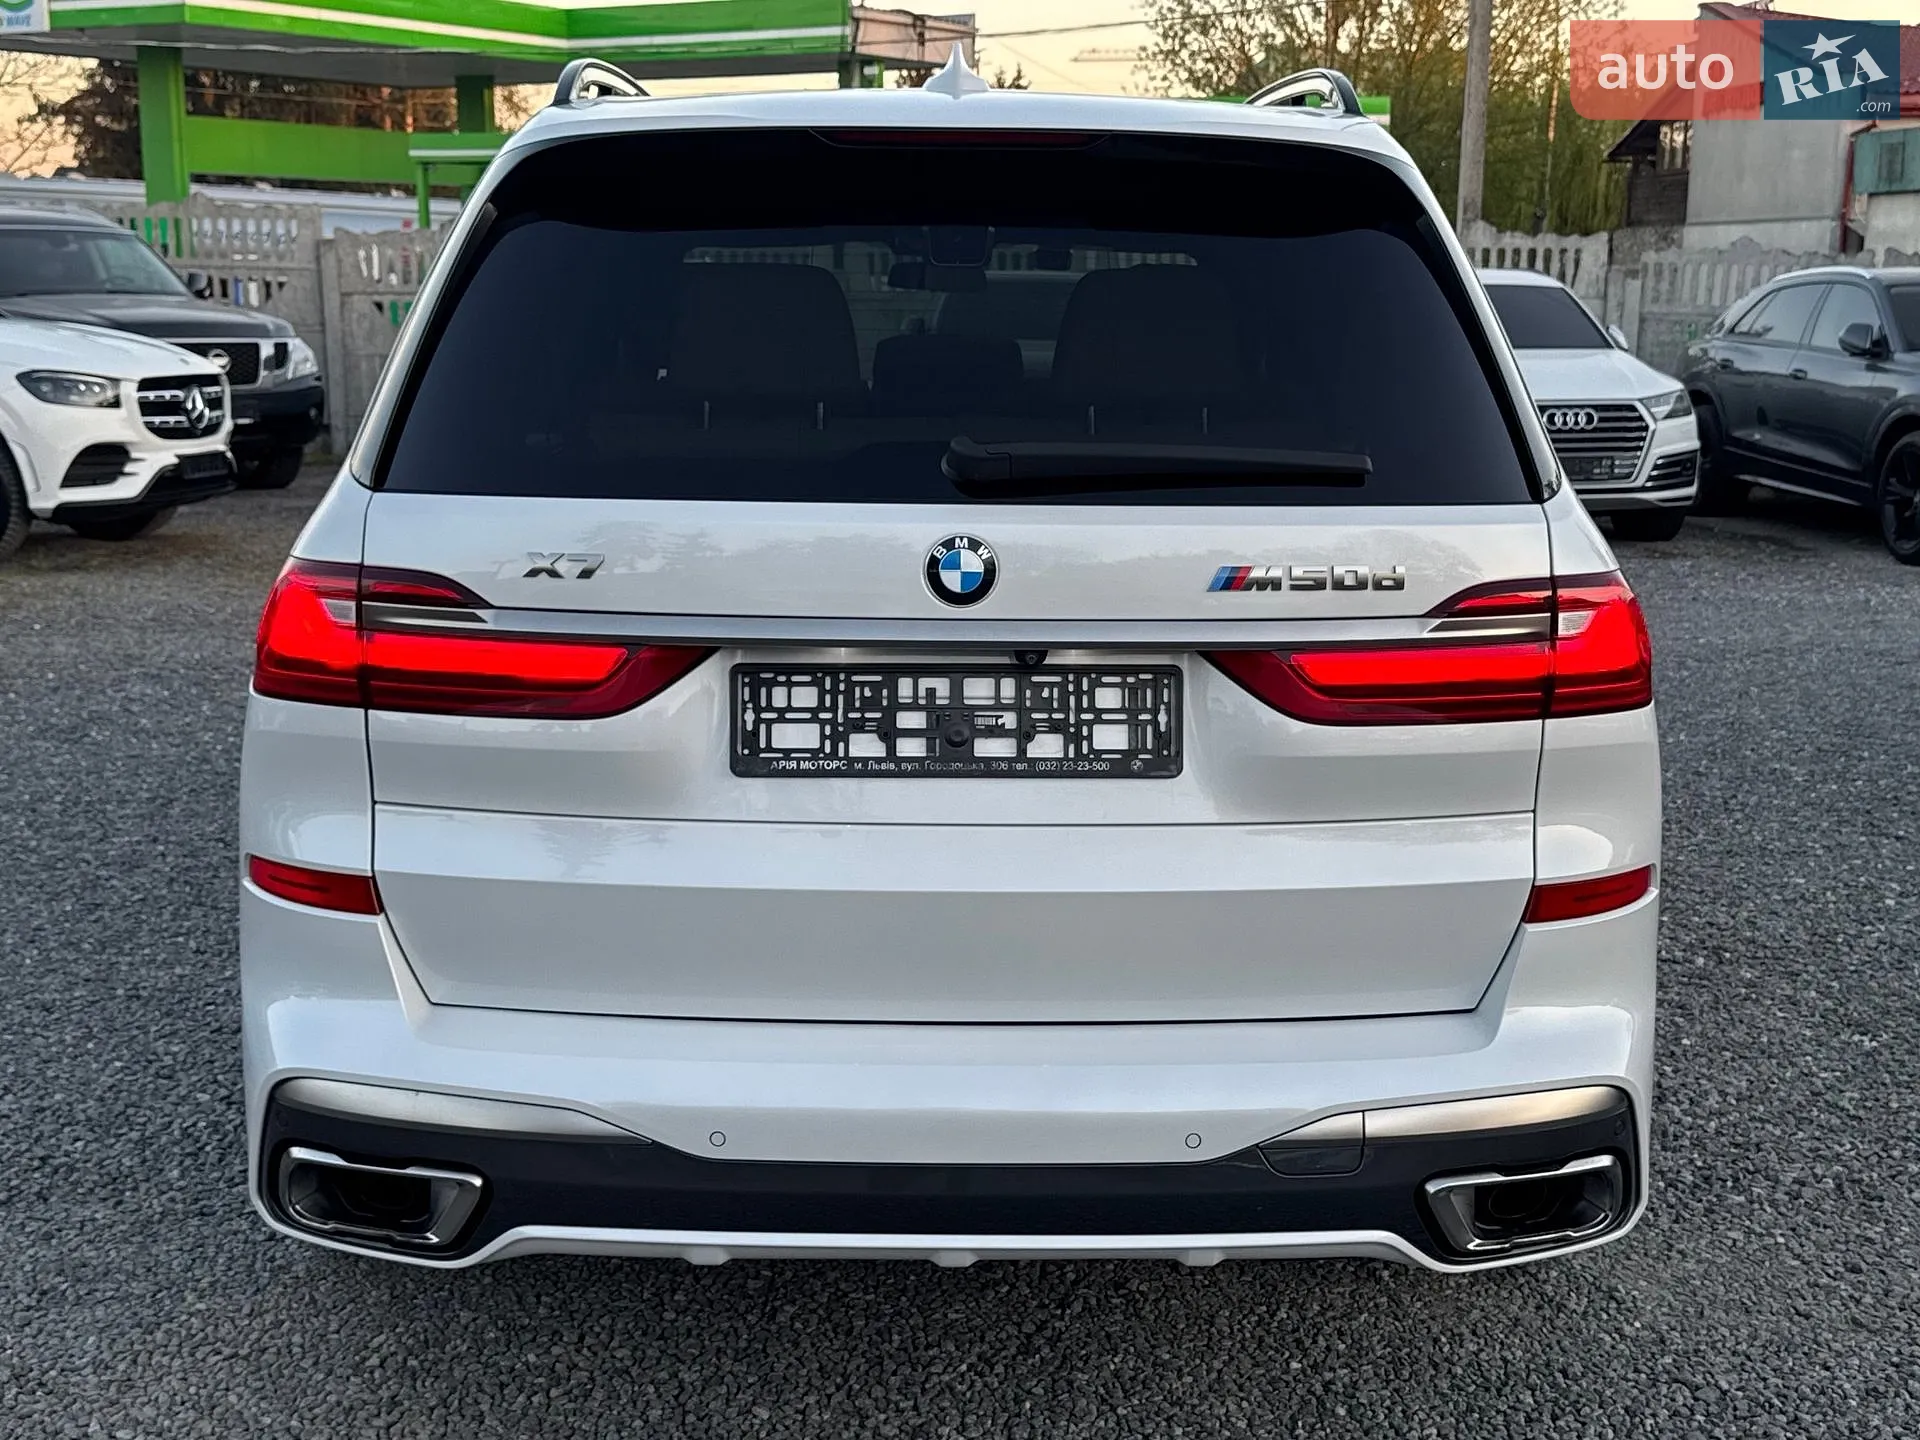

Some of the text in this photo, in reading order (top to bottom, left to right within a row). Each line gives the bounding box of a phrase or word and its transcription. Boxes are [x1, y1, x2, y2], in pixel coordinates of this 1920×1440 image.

[932, 537, 992, 561] BMW
[522, 551, 605, 579] X7
[1246, 565, 1406, 591] M50d
[770, 760, 797, 770] АРІЯ
[800, 760, 848, 770] МОТОРС
[1035, 760, 1060, 771] (032)
[1062, 760, 1110, 770] 23-23-500
